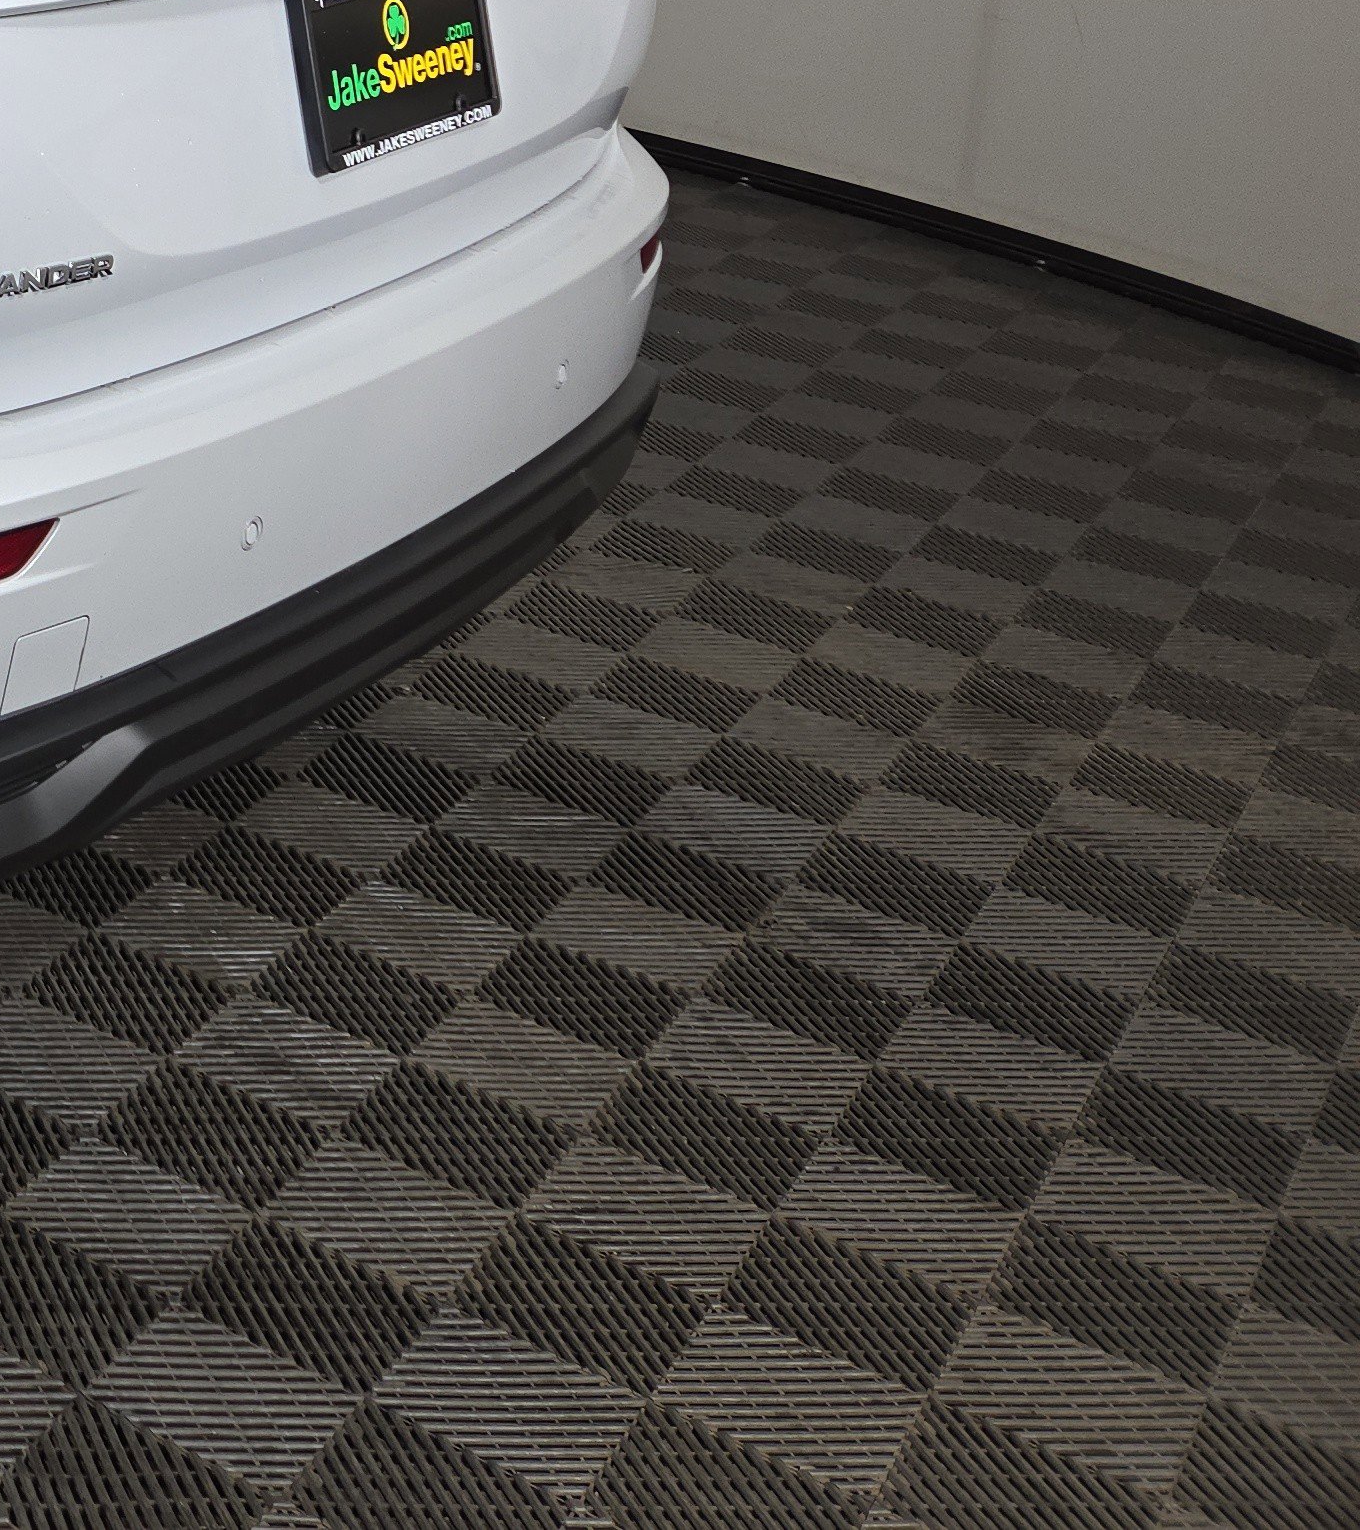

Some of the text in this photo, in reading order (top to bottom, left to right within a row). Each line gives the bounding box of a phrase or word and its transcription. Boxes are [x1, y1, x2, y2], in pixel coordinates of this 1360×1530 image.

[444, 21, 473, 42] .com
[327, 38, 474, 111] JakeSweeney
[342, 105, 493, 167] WWW.JAKESWEENEY.COM
